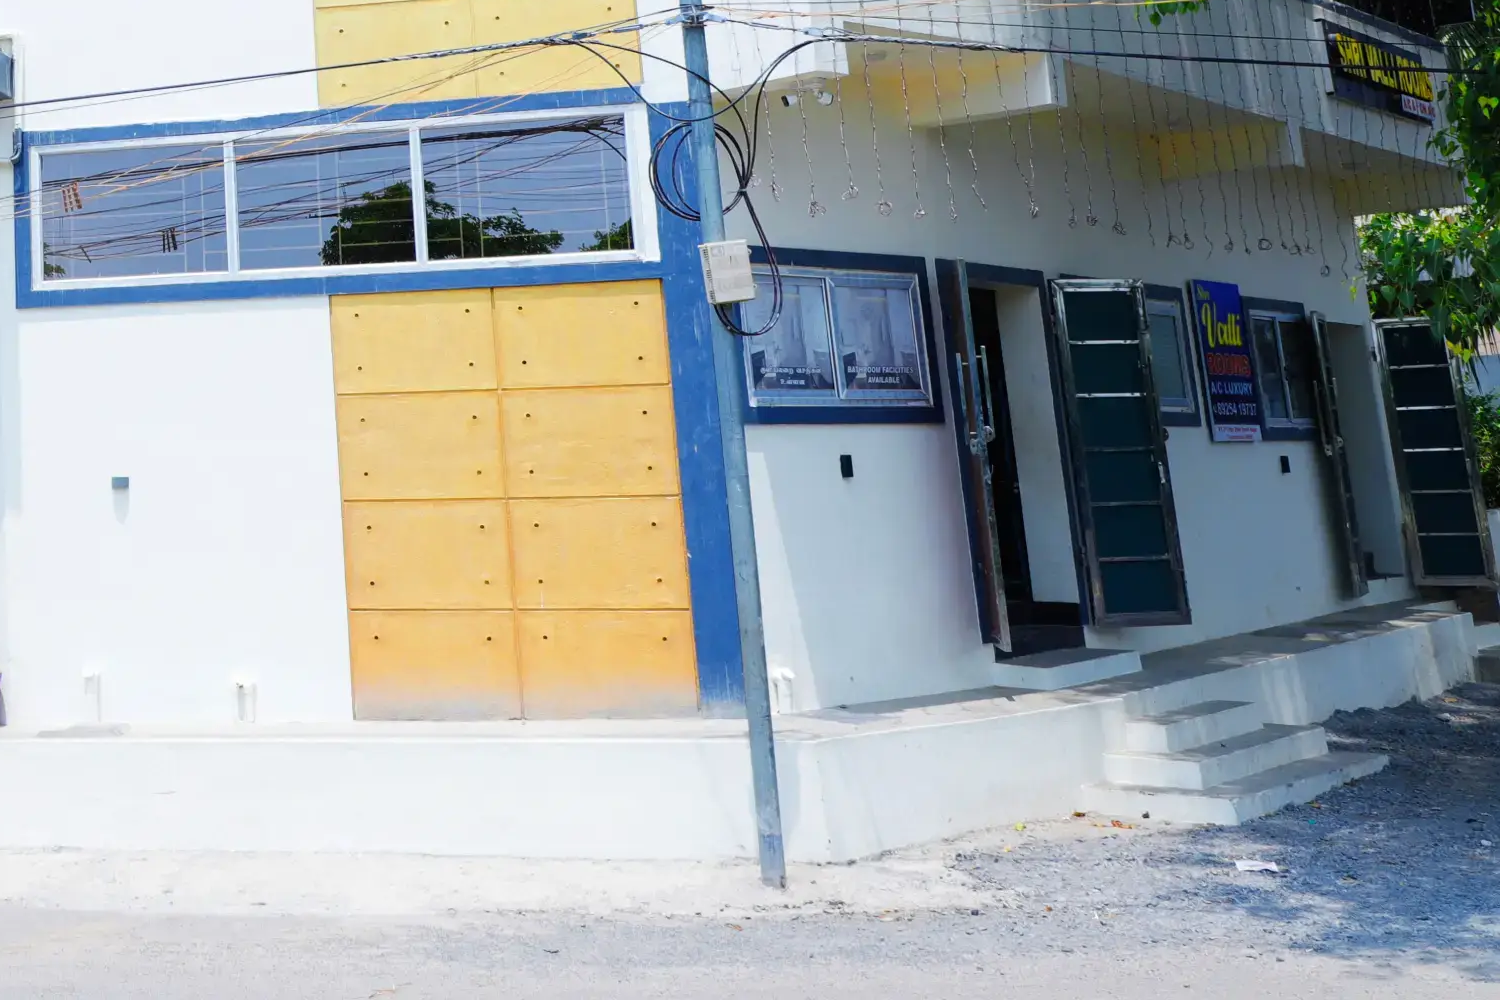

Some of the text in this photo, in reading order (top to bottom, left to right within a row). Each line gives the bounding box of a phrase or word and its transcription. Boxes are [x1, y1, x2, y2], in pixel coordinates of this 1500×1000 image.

[1336, 34, 1367, 79] SHRI
[1364, 44, 1398, 89] VALLI
[1201, 301, 1243, 348] Valli
[847, 365, 881, 373] BATHROOM
[1206, 353, 1252, 378] ROOMS
[868, 376, 900, 384] AVAILABLE
[1211, 381, 1253, 396] A/C LUXURY
